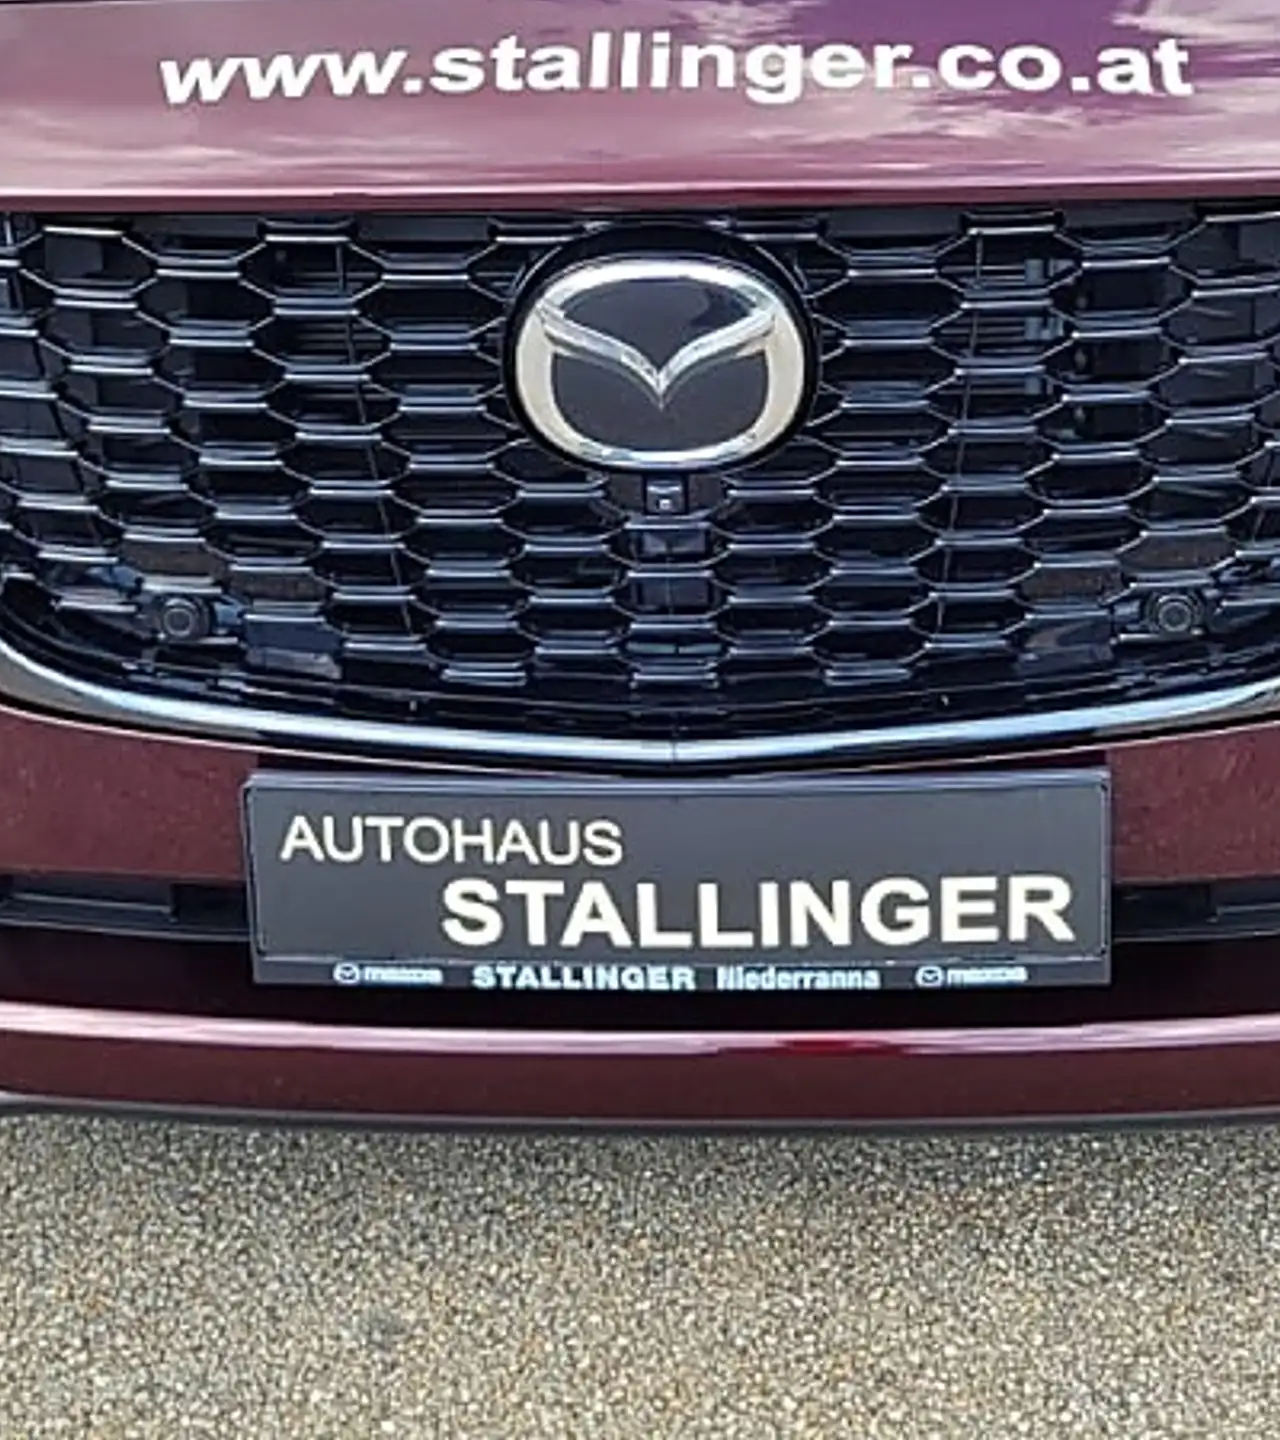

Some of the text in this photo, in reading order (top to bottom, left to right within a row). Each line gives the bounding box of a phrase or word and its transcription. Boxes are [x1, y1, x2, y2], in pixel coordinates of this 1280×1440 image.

[159, 32, 1193, 104] www.stallinger.co.at
[280, 815, 622, 866] AUTOHAUS
[442, 875, 1074, 947] STALLINGER
[472, 964, 696, 990] STALLINGER
[717, 965, 881, 990] Niederranna
